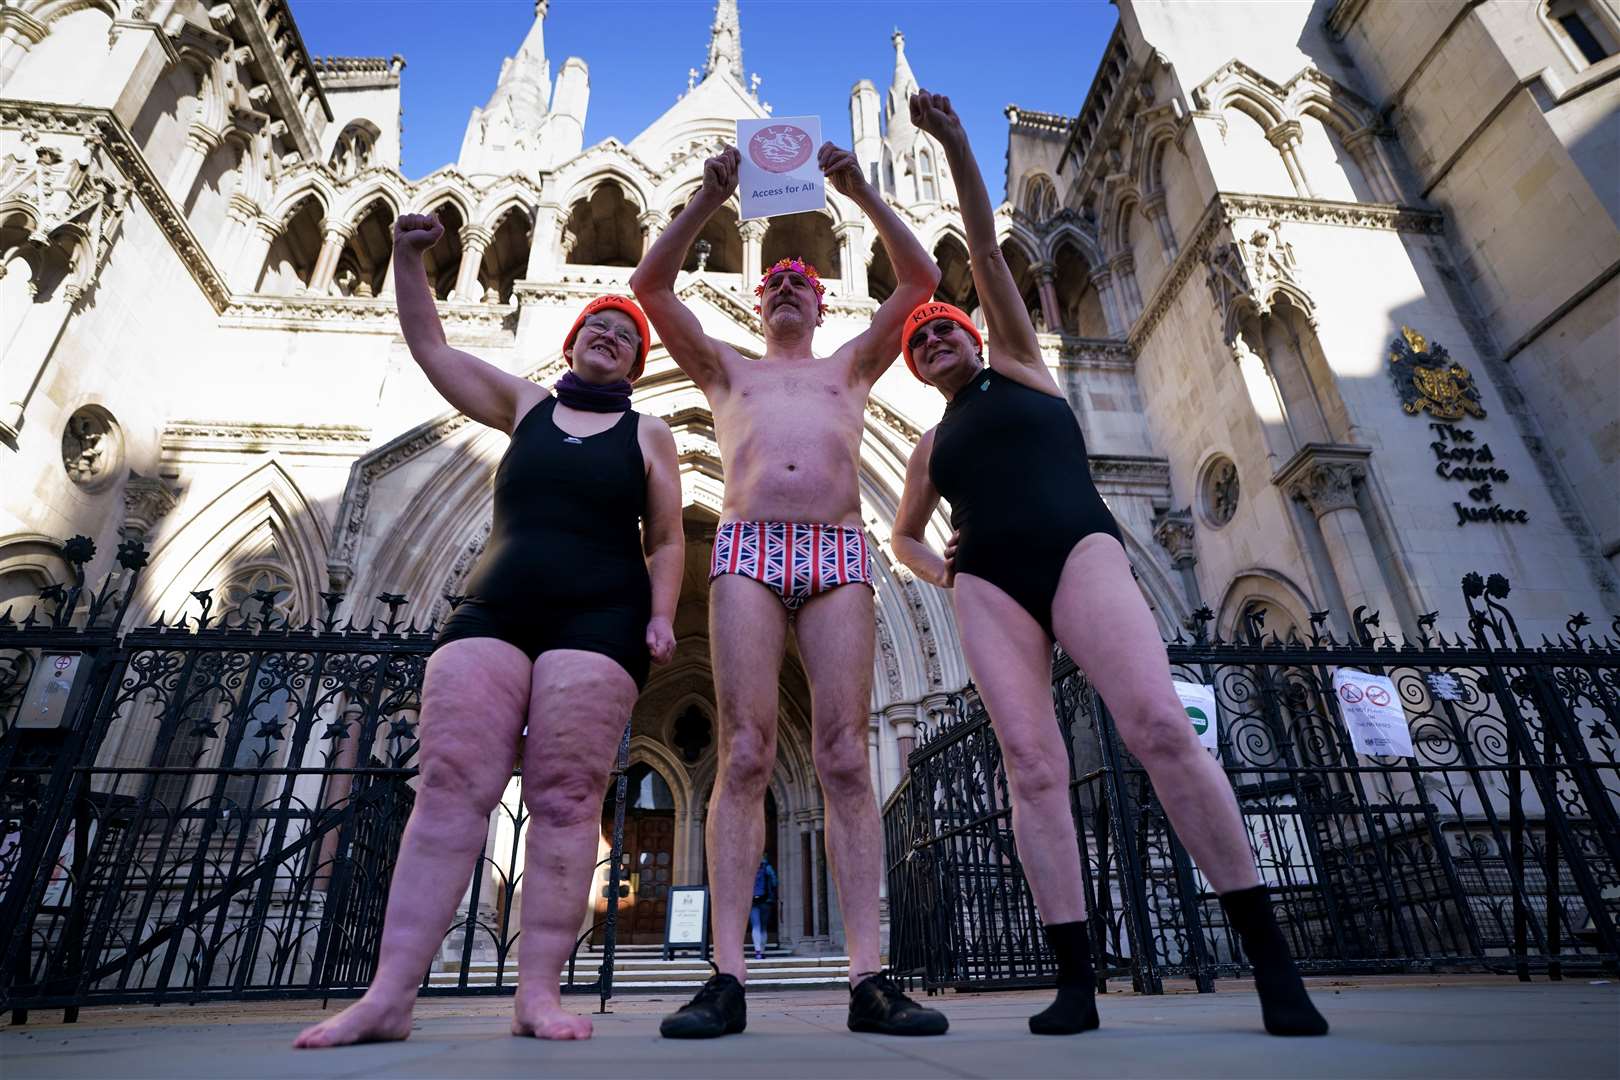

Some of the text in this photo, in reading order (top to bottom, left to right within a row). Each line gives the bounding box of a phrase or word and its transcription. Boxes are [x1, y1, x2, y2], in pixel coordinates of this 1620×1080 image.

[752, 183, 814, 198] Access for All
[913, 306, 950, 323] KLPA
[1429, 423, 1475, 442] The
[1430, 442, 1494, 464] Royal
[1437, 462, 1509, 482] Courts
[1469, 484, 1493, 502] of
[1453, 503, 1529, 526] Justice
